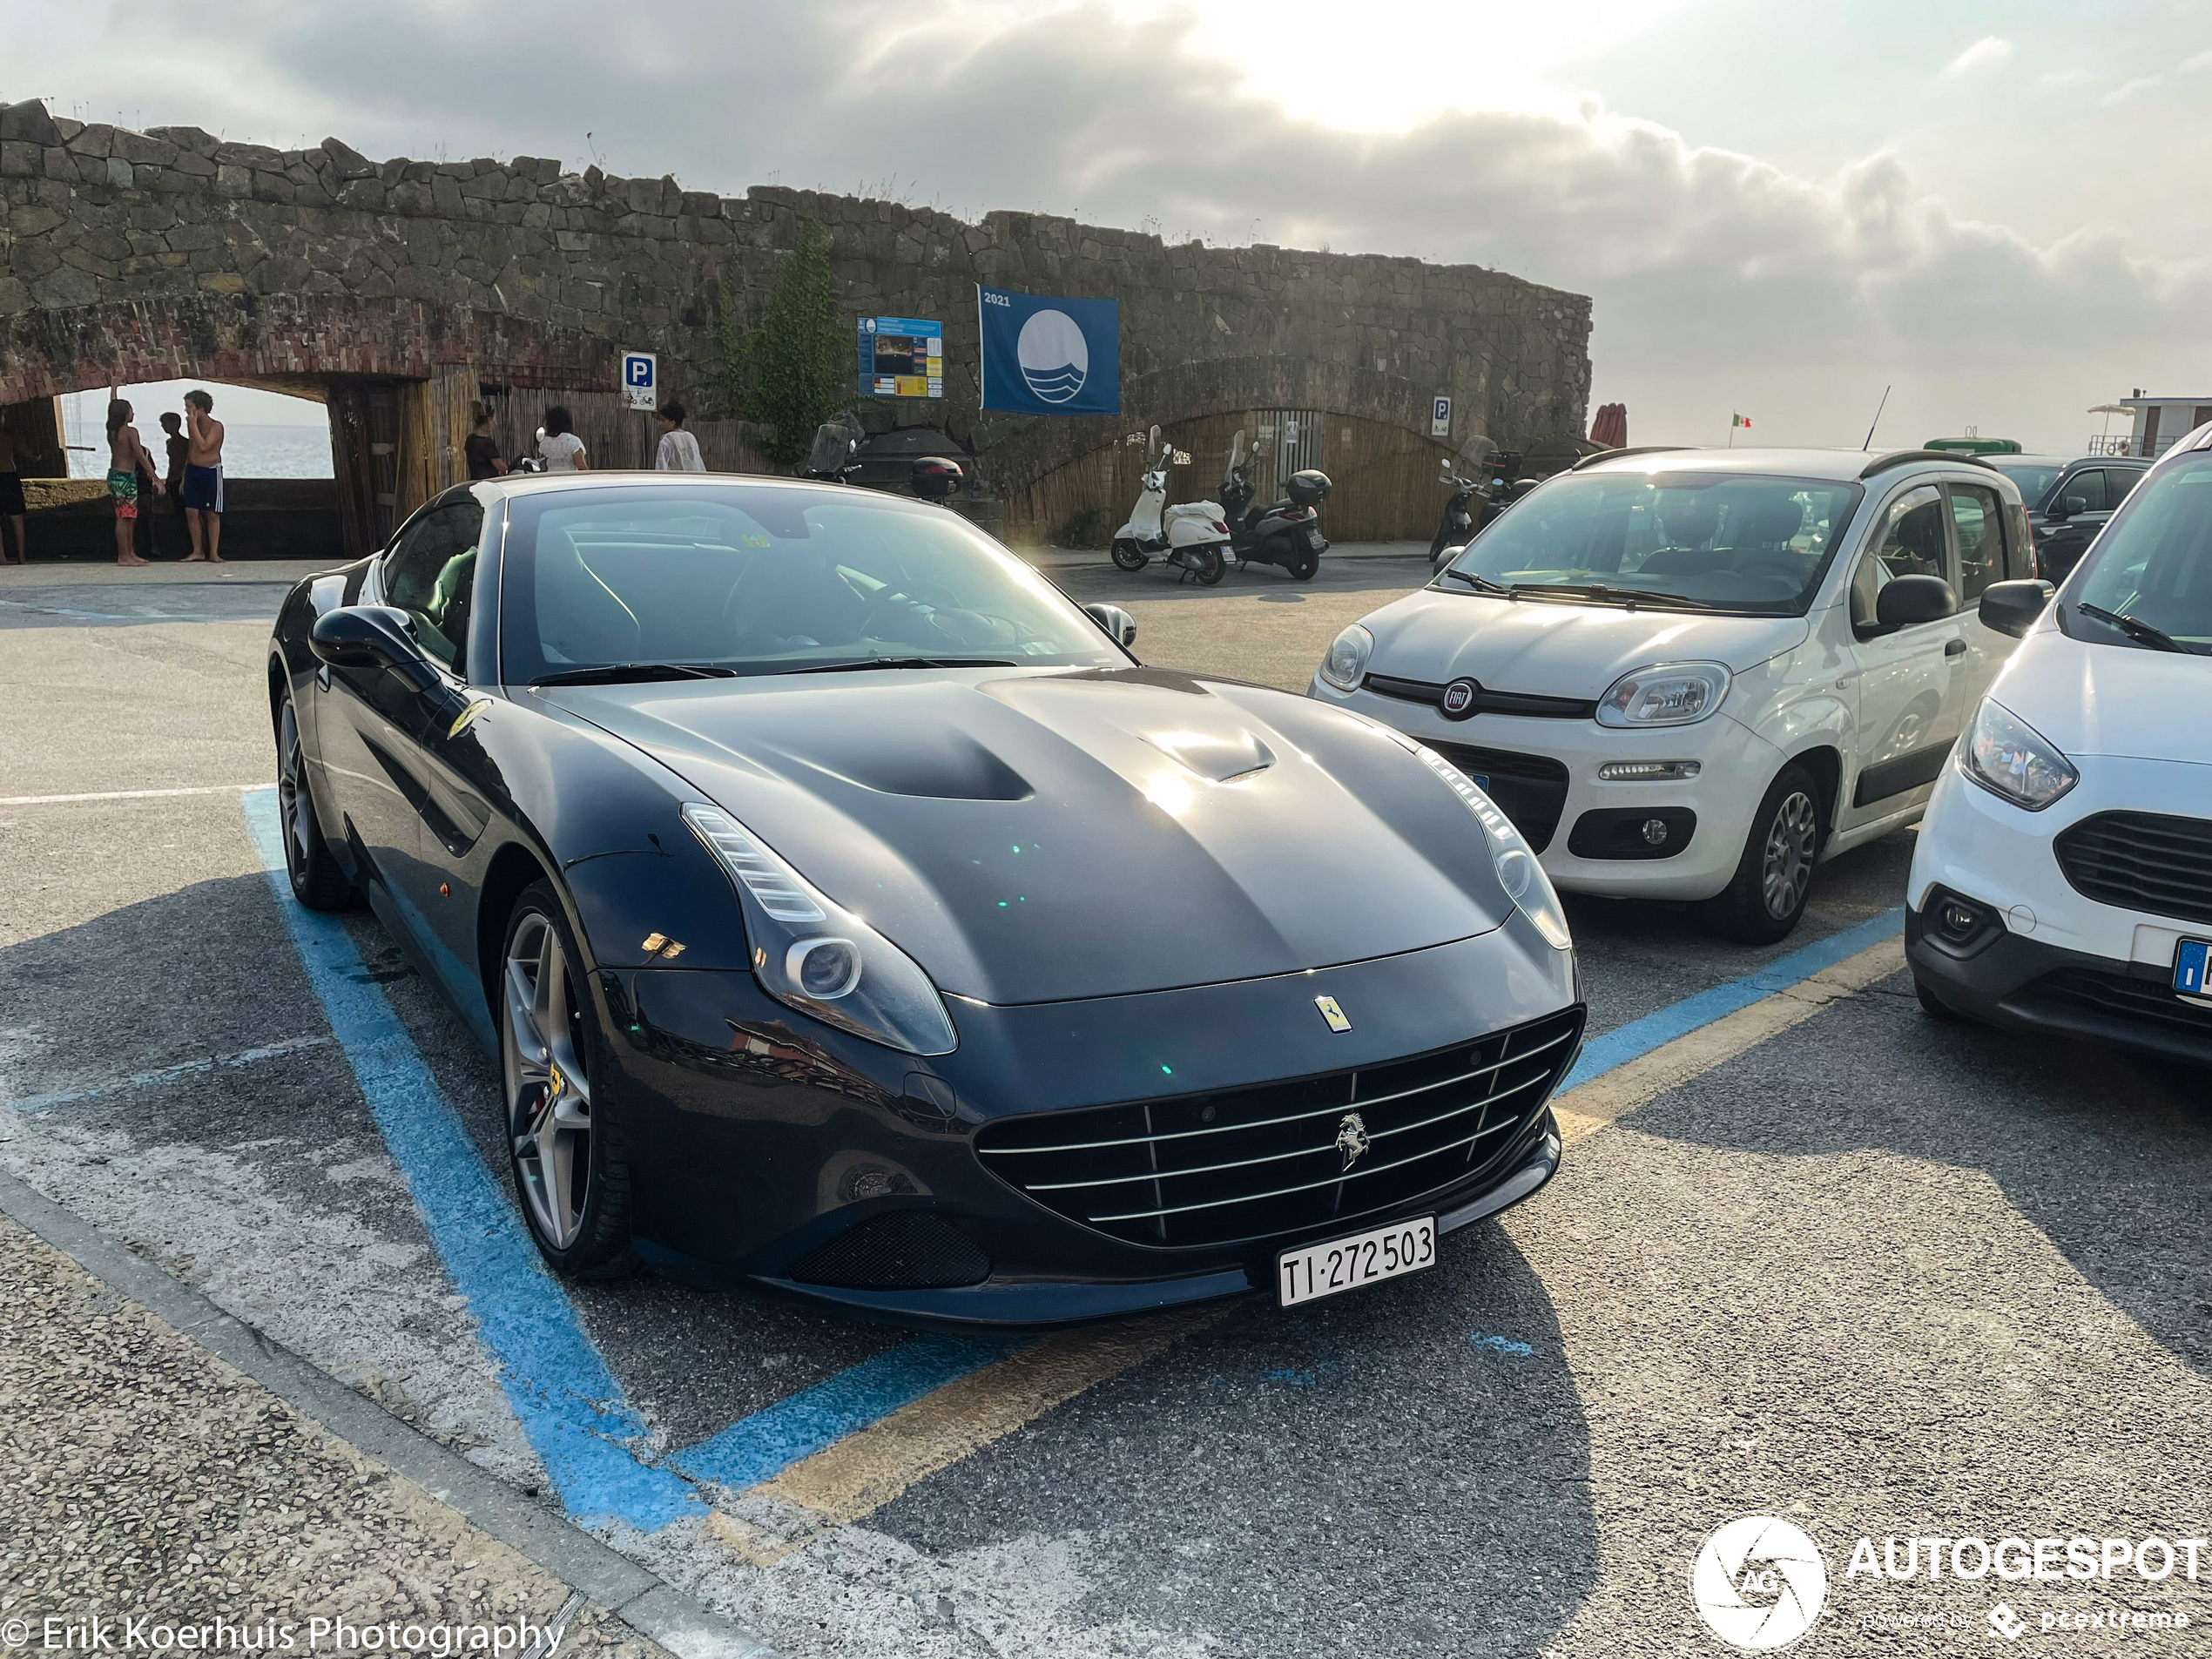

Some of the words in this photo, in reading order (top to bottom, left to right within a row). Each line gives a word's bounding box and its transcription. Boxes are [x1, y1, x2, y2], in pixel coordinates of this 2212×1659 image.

[984, 292, 1011, 307] 2021
[632, 361, 648, 382] P
[1438, 402, 1447, 417] P
[1448, 691, 1467, 705] FIAT
